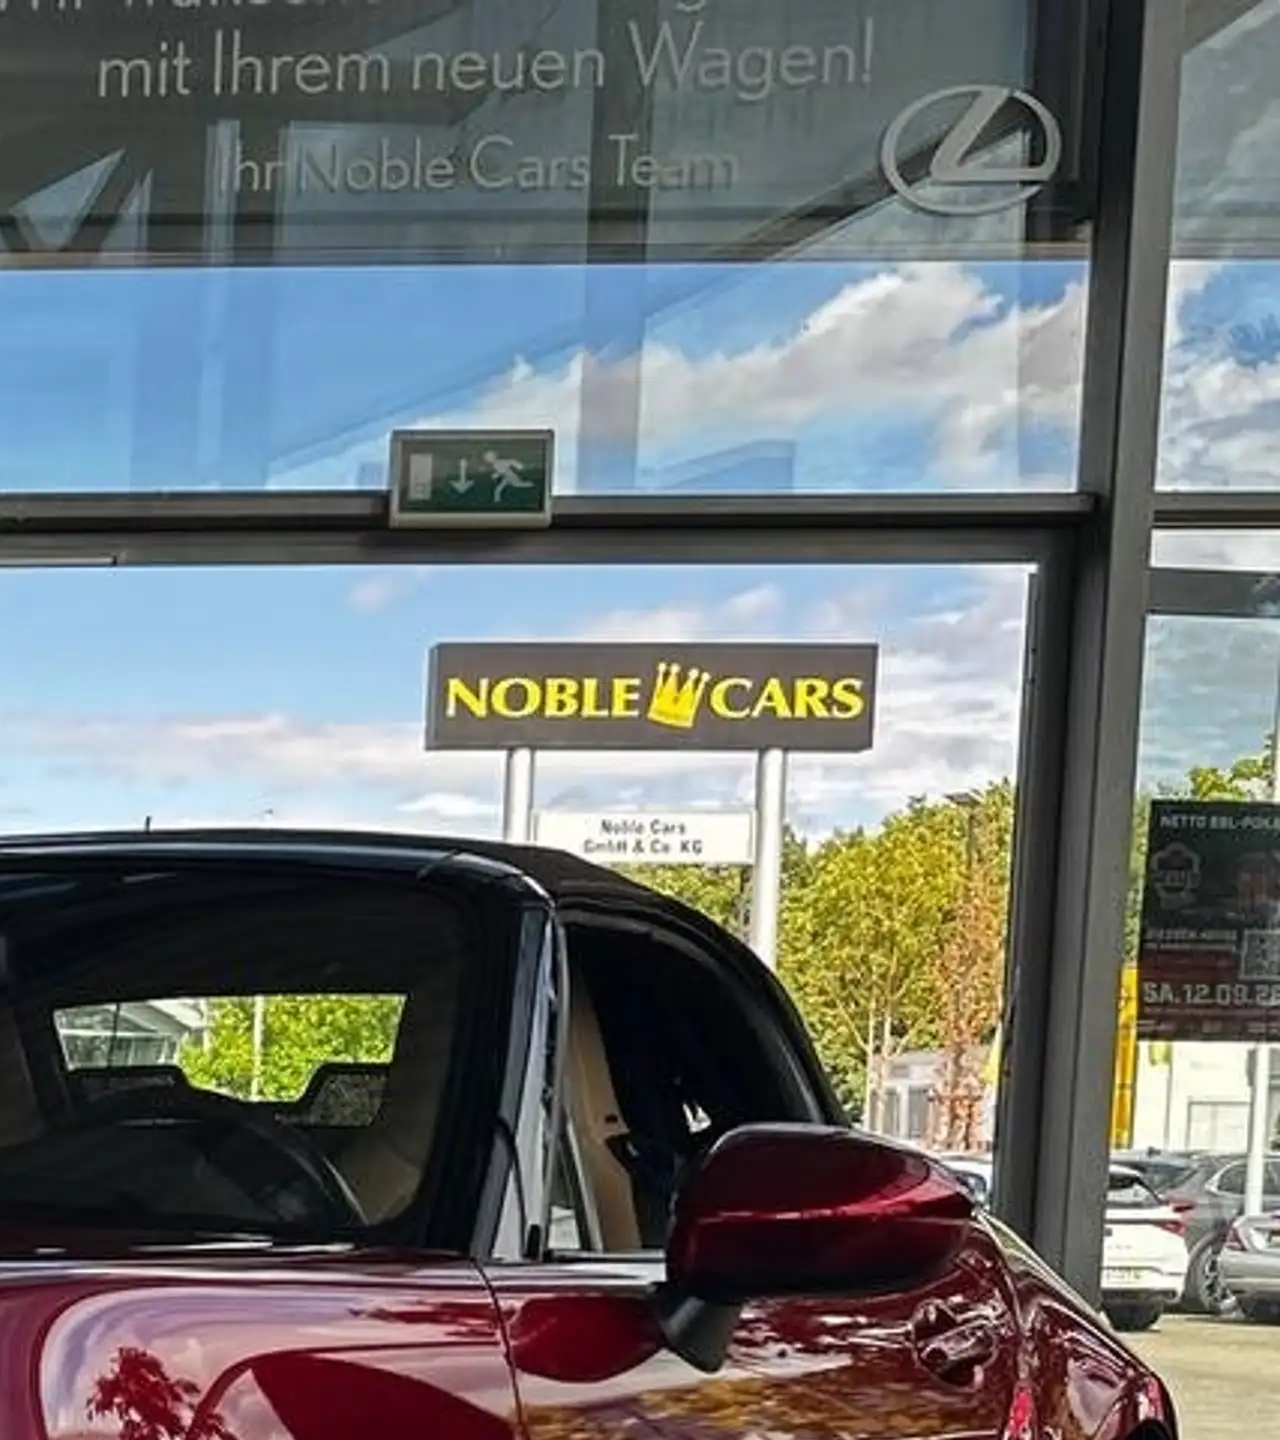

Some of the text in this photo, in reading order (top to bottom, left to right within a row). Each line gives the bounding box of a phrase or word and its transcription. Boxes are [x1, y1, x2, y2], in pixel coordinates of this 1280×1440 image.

[98, 17, 874, 100] mit Ihrem neuen Wagen!
[221, 133, 738, 193] Ihr Noble Cars Team
[445, 677, 865, 719] NOBLE CARS
[583, 840, 628, 855] GmbH
[632, 840, 645, 854] &
[680, 840, 703, 855] KG
[601, 819, 686, 835] Noble Cars
